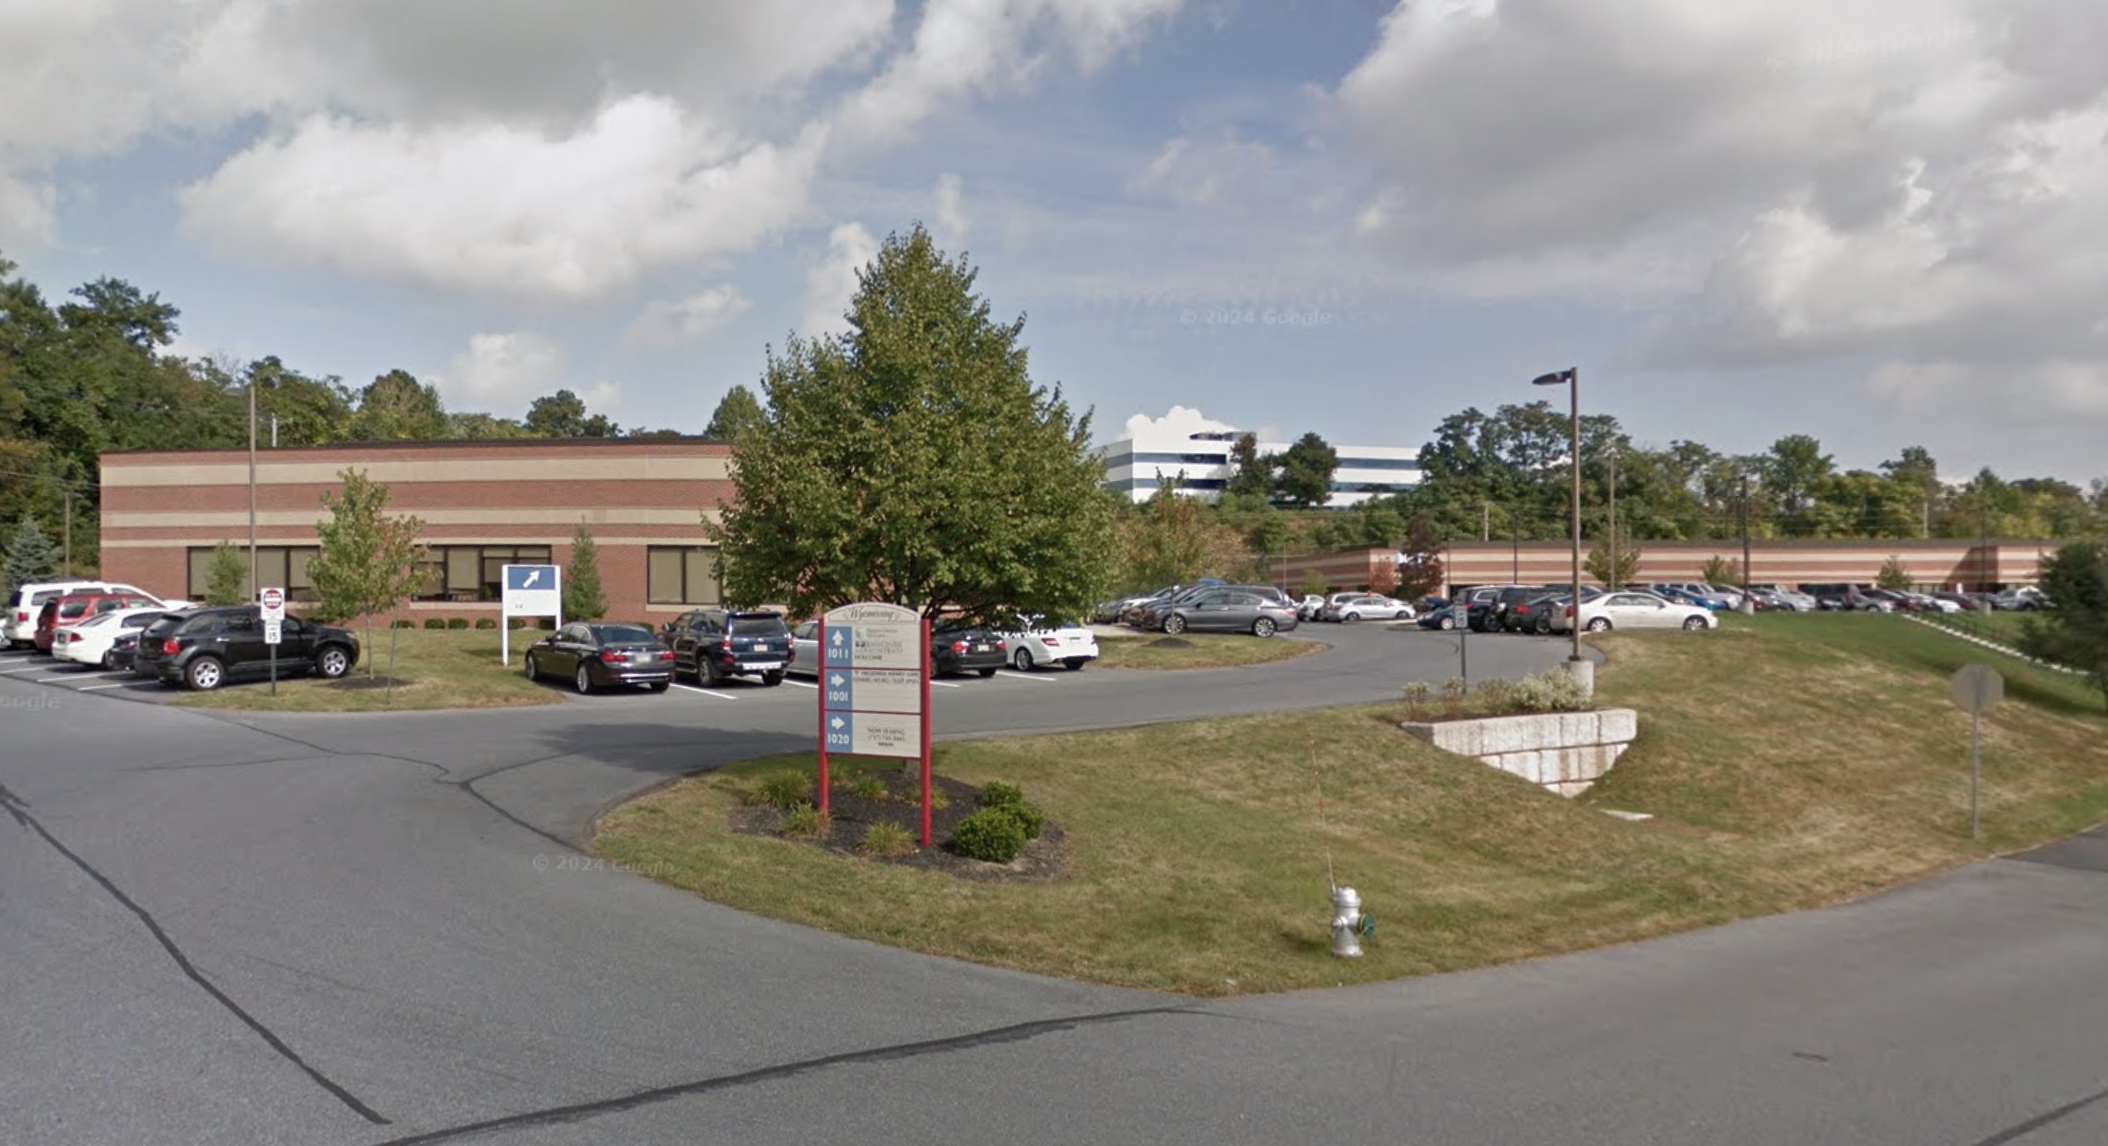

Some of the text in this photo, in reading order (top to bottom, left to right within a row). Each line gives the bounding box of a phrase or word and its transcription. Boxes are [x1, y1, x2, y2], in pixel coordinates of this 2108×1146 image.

[268, 631, 278, 642] 15
[828, 648, 849, 659] 1011
[829, 691, 849, 701] 1001
[827, 733, 850, 744] 1020
